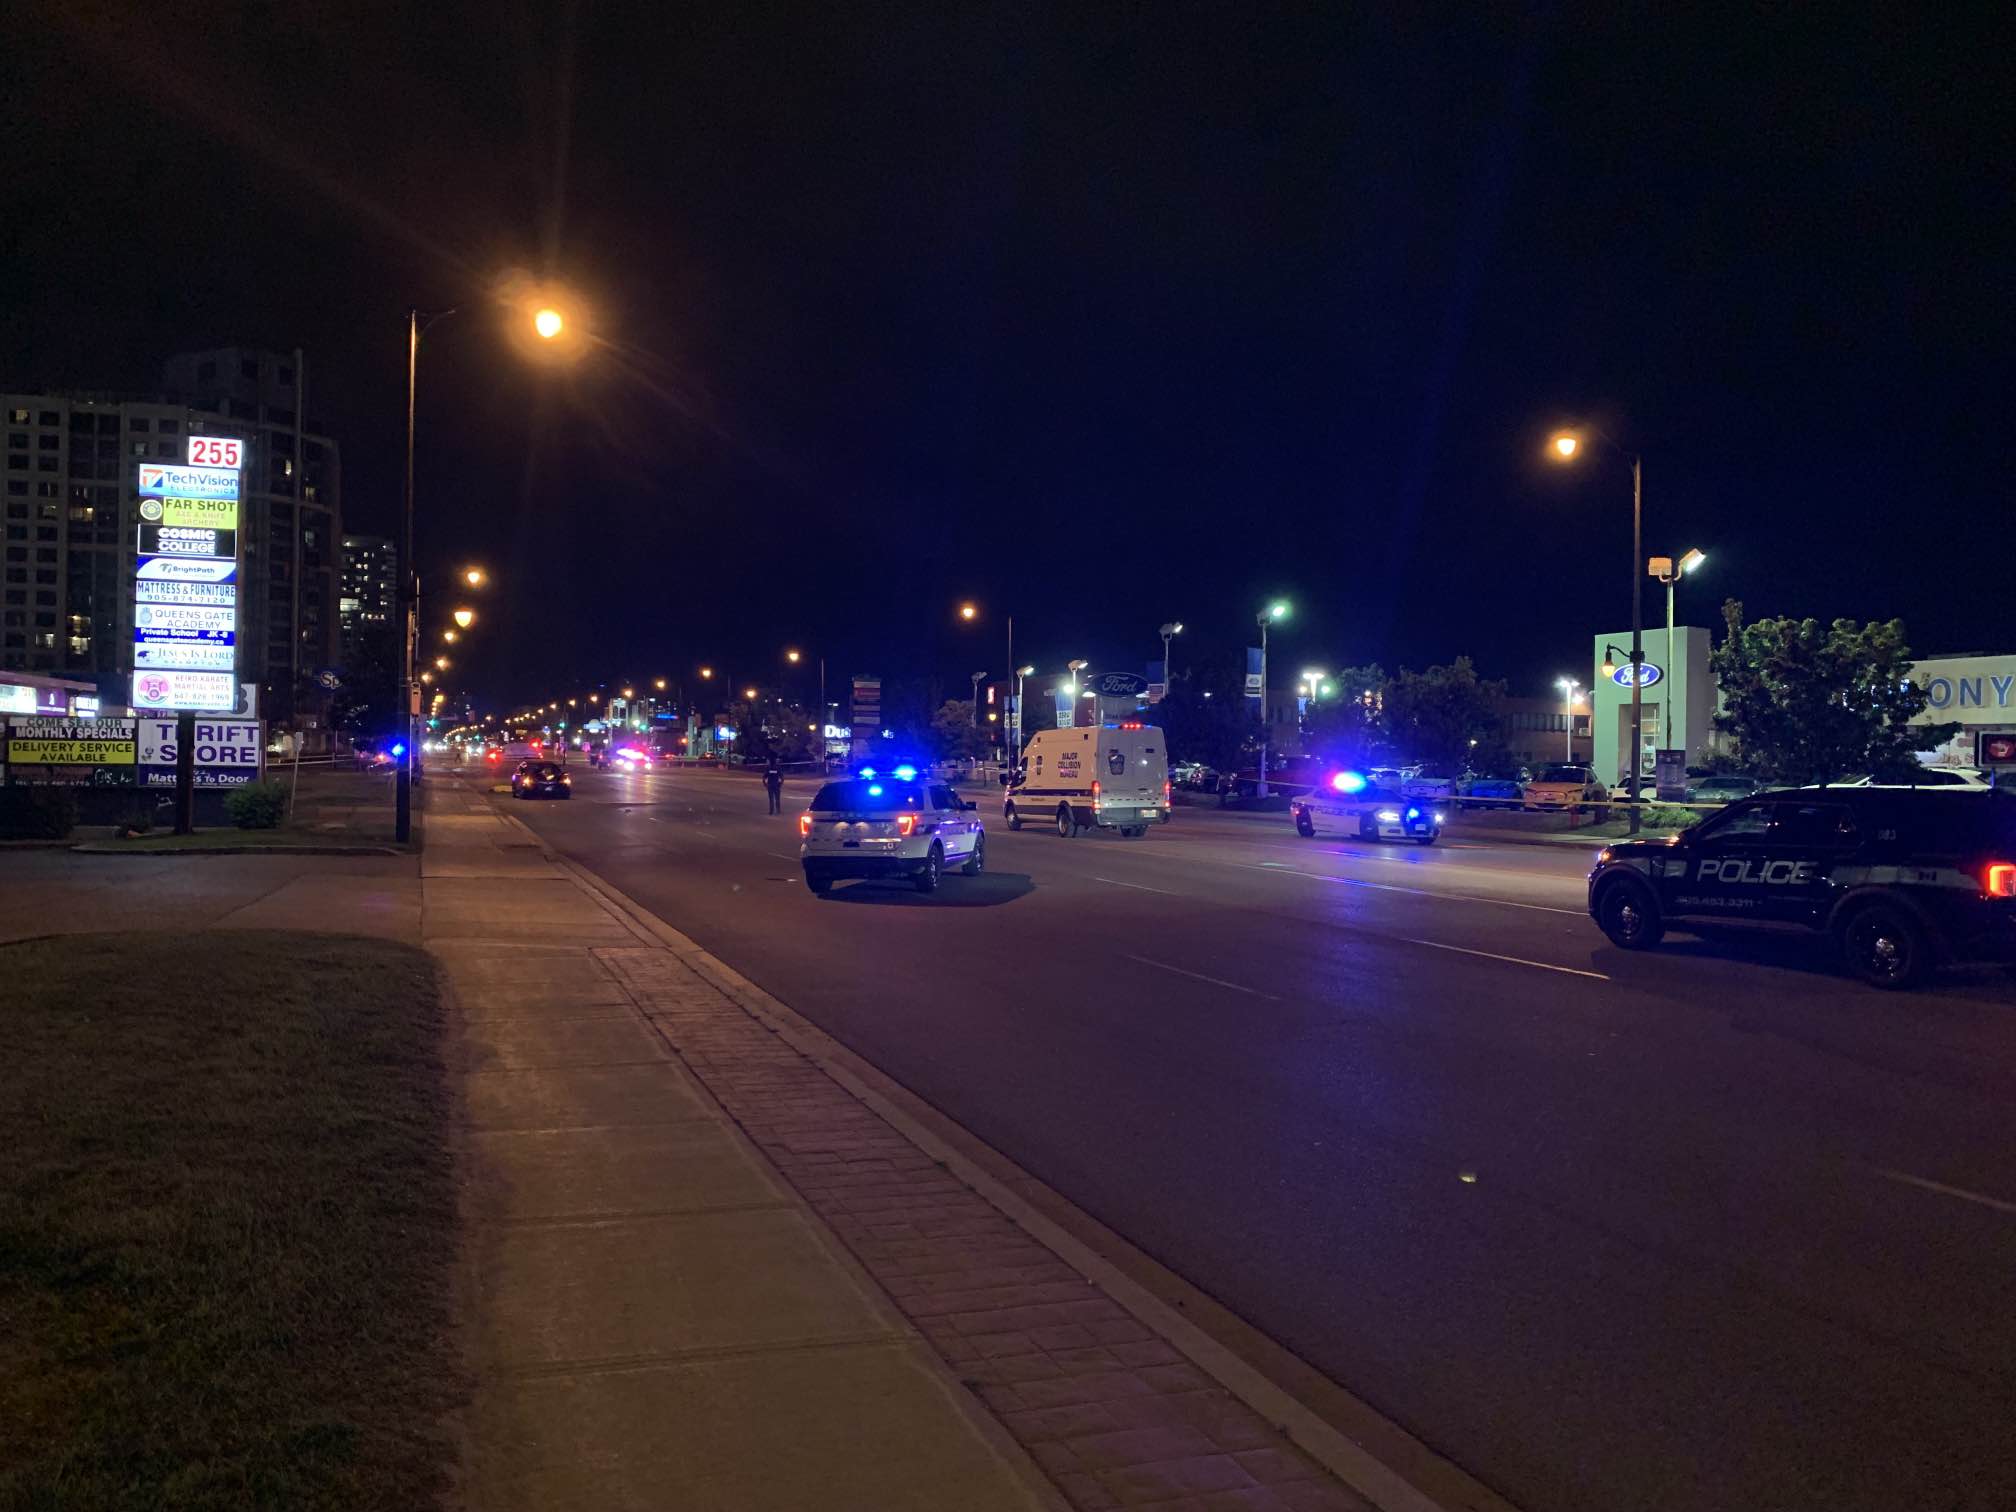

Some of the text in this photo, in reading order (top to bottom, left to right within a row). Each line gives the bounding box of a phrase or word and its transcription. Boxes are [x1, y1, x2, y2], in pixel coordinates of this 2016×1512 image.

[193, 440, 238, 466] 255
[165, 471, 239, 487] TechVision
[165, 500, 192, 510] FAR
[197, 501, 236, 512] SHOT
[158, 527, 216, 540] COSMIC
[158, 540, 215, 553] COLLEGE
[173, 566, 215, 574] BrightPath
[137, 582, 235, 597] MATTRESS & FURNITURE
[155, 609, 233, 621] QUEENS GATE
[167, 619, 221, 629] ACADEMY
[141, 628, 169, 636] Private
[170, 629, 199, 637] School
[1620, 667, 1650, 684] Fd
[1102, 675, 1138, 692] Ford
[27, 718, 122, 728] COME SEE OUR
[16, 727, 133, 739] MONTHLY SPECIALS
[156, 724, 259, 742] TRIFT
[12, 741, 132, 752] DELIVERY SERVICE
[40, 753, 107, 762] AVAILABLE
[159, 745, 256, 763] SORE
[218, 774, 249, 783] Door
[1696, 859, 1819, 885] POLICE
